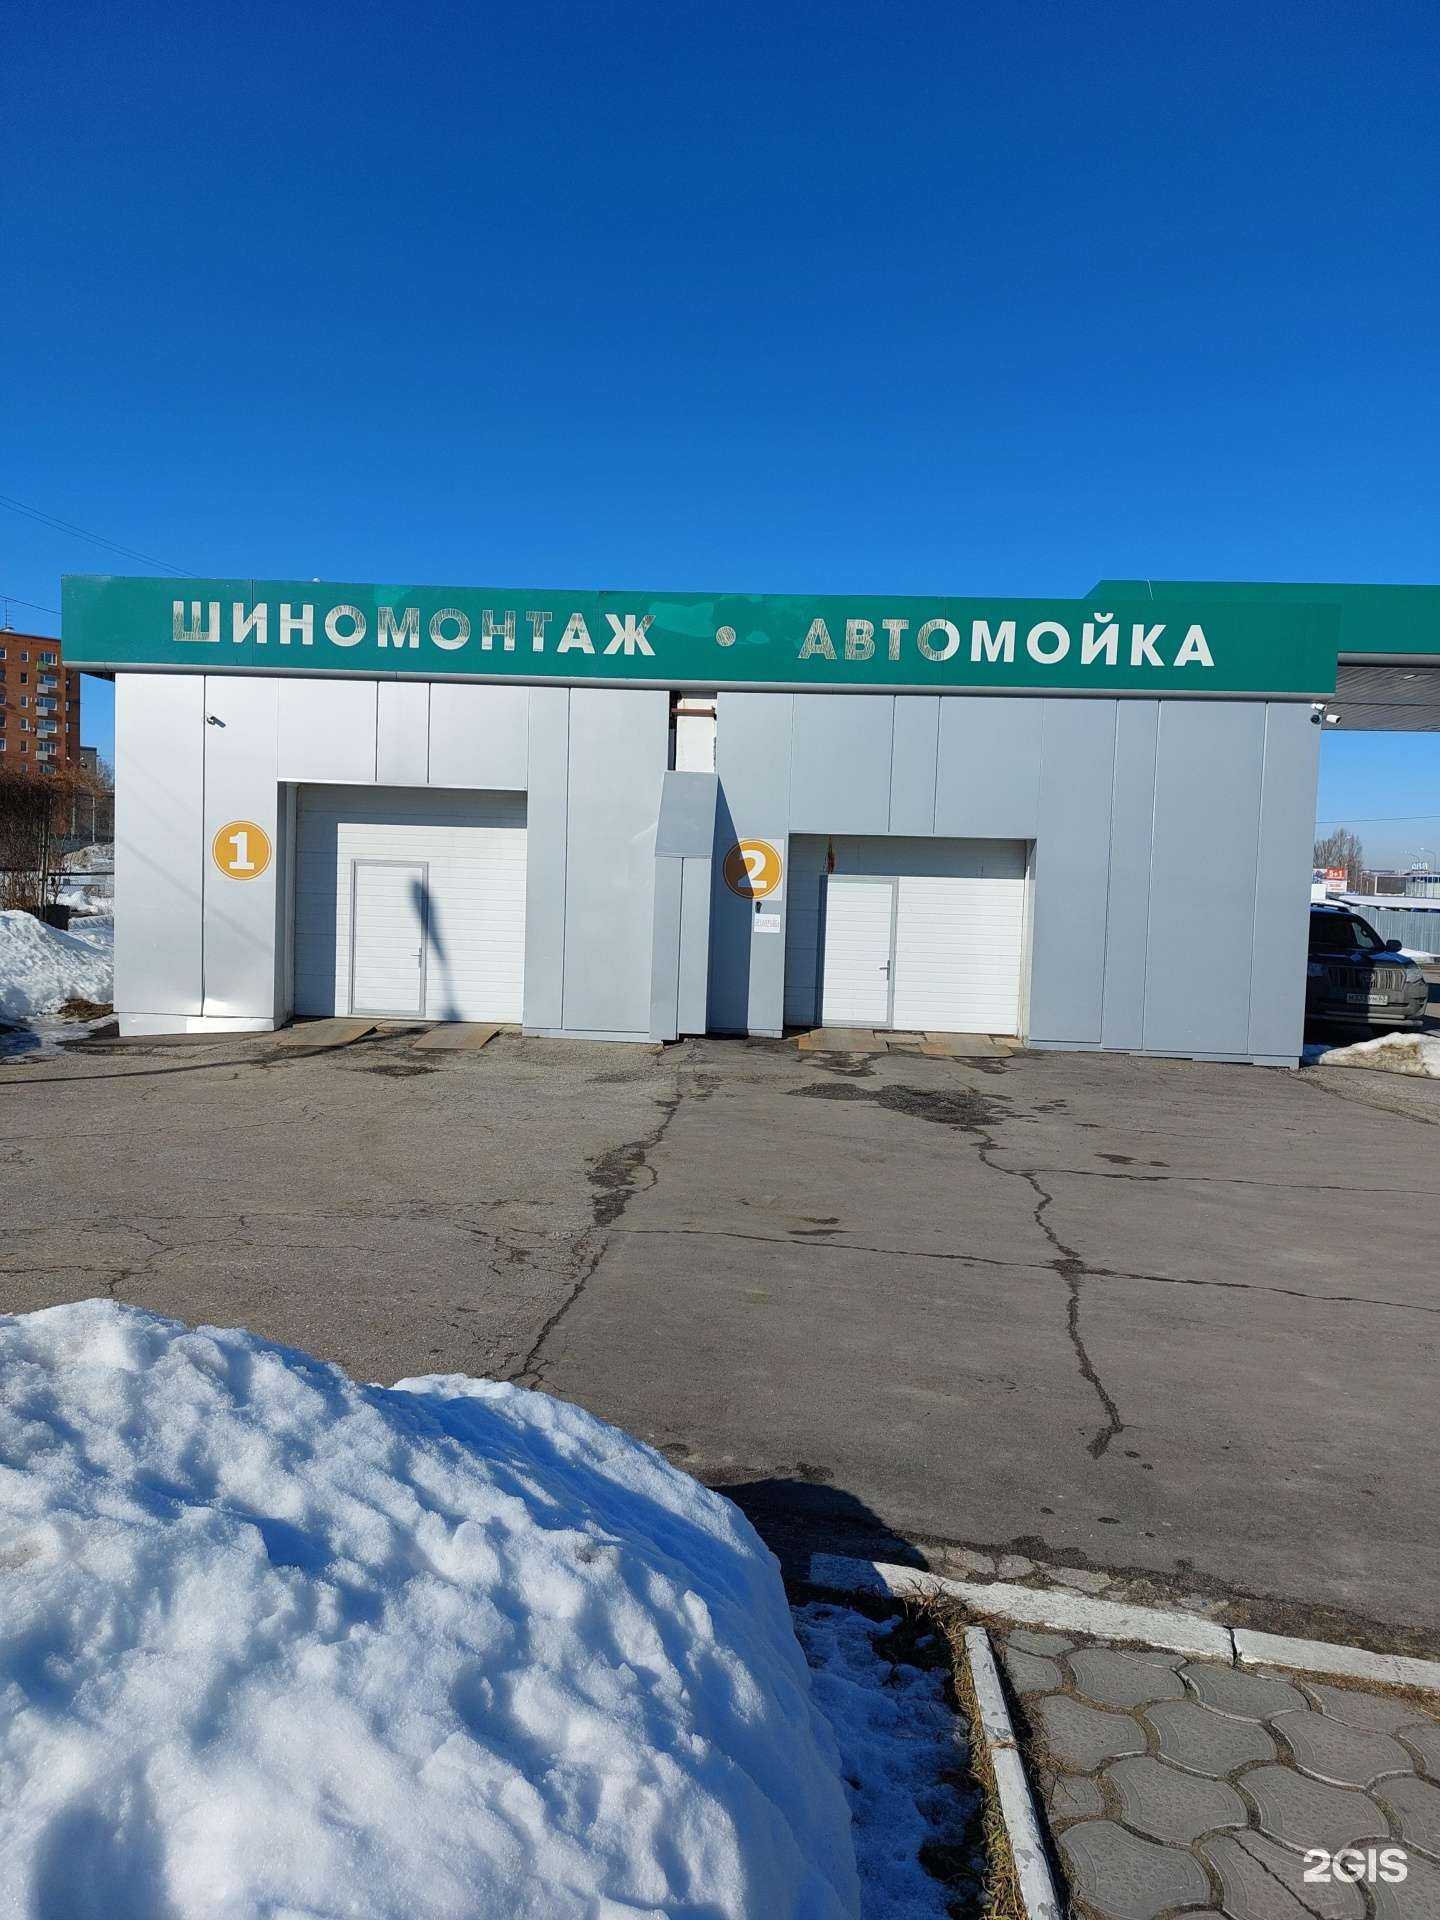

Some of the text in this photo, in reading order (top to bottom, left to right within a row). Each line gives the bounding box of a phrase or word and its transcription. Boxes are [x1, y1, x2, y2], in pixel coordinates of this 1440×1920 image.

[172, 600, 1215, 667] ШИНОМОНТАЖ АВТОМОЙКА
[228, 831, 255, 870] 1
[737, 849, 768, 889] 2
